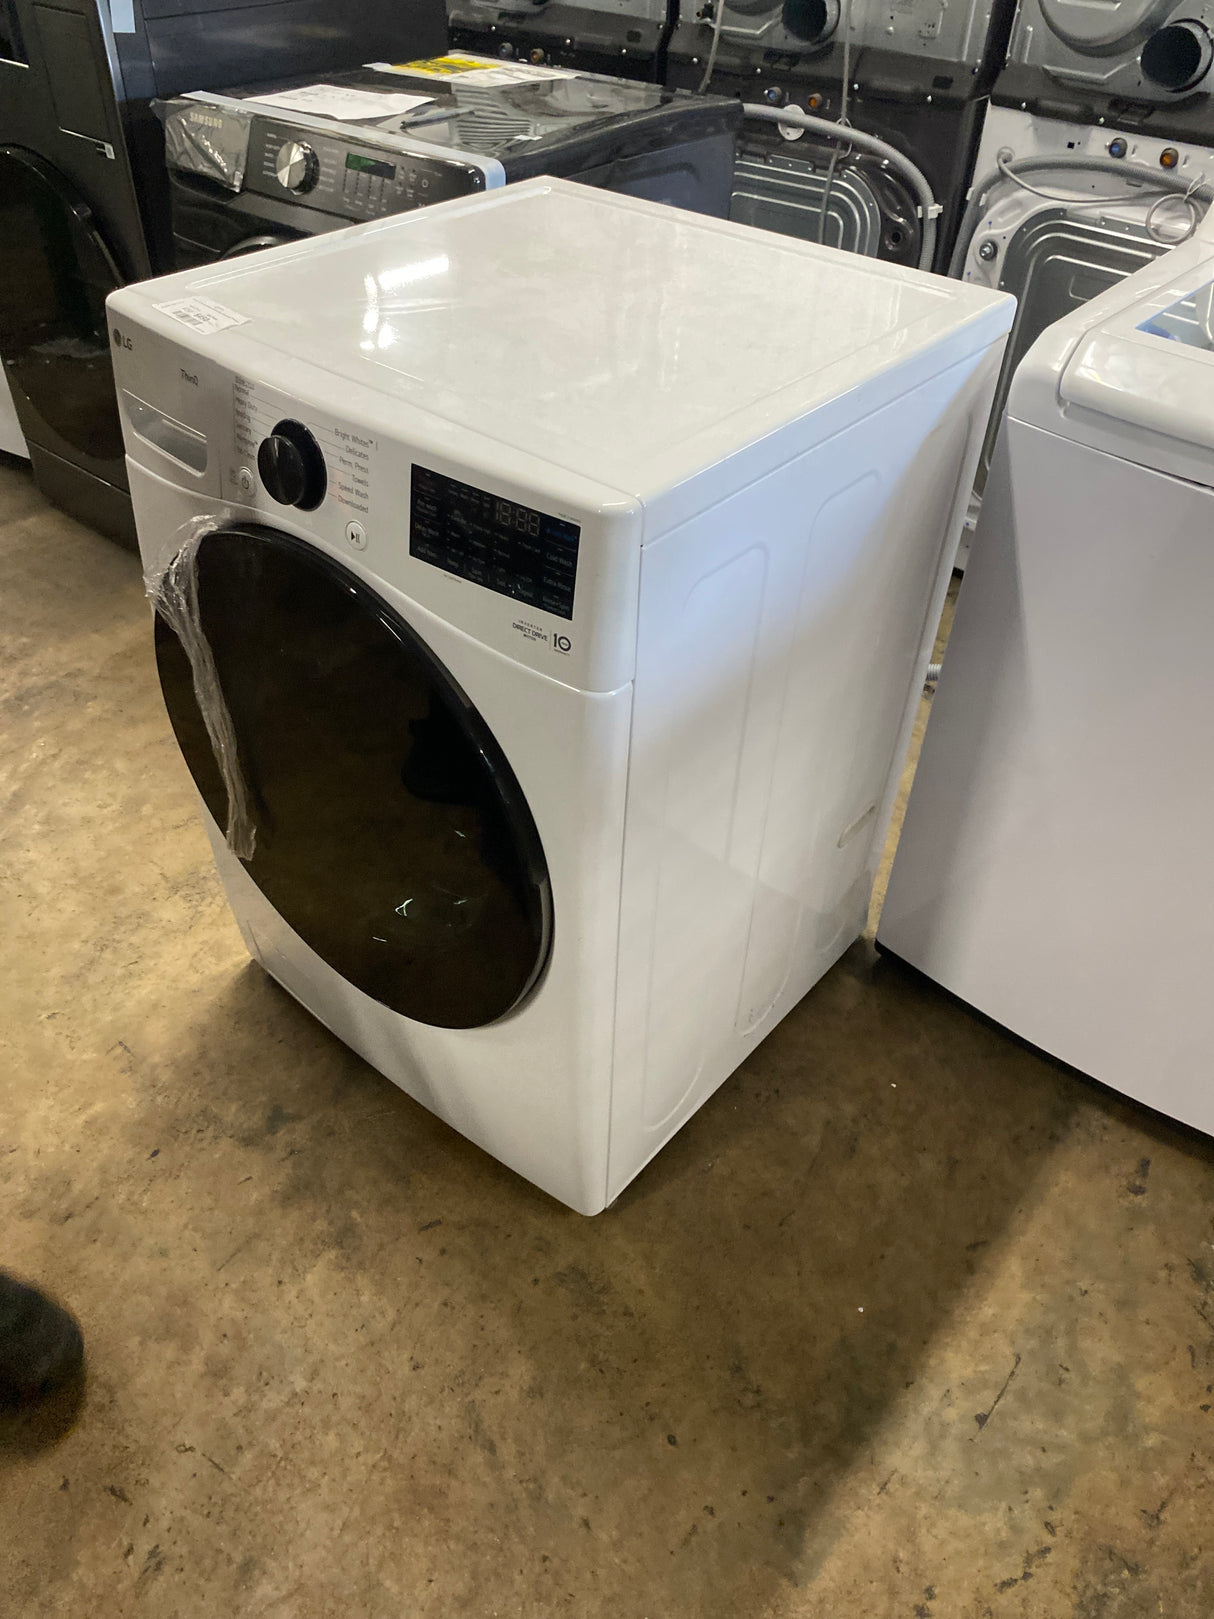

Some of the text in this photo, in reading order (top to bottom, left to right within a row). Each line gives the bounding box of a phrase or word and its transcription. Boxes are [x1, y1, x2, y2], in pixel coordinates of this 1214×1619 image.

[190, 112, 223, 129] SAMSUNG
[122, 335, 133, 350] LG
[334, 428, 349, 441] Bright
[345, 445, 369, 461] Delicates
[355, 462, 369, 474] Press
[352, 474, 369, 487] Towels
[338, 481, 369, 500] Speed Wash
[337, 495, 369, 514] Downloaded
[512, 622, 548, 642] DIRECT DRIVE
[553, 633, 572, 652] 10
